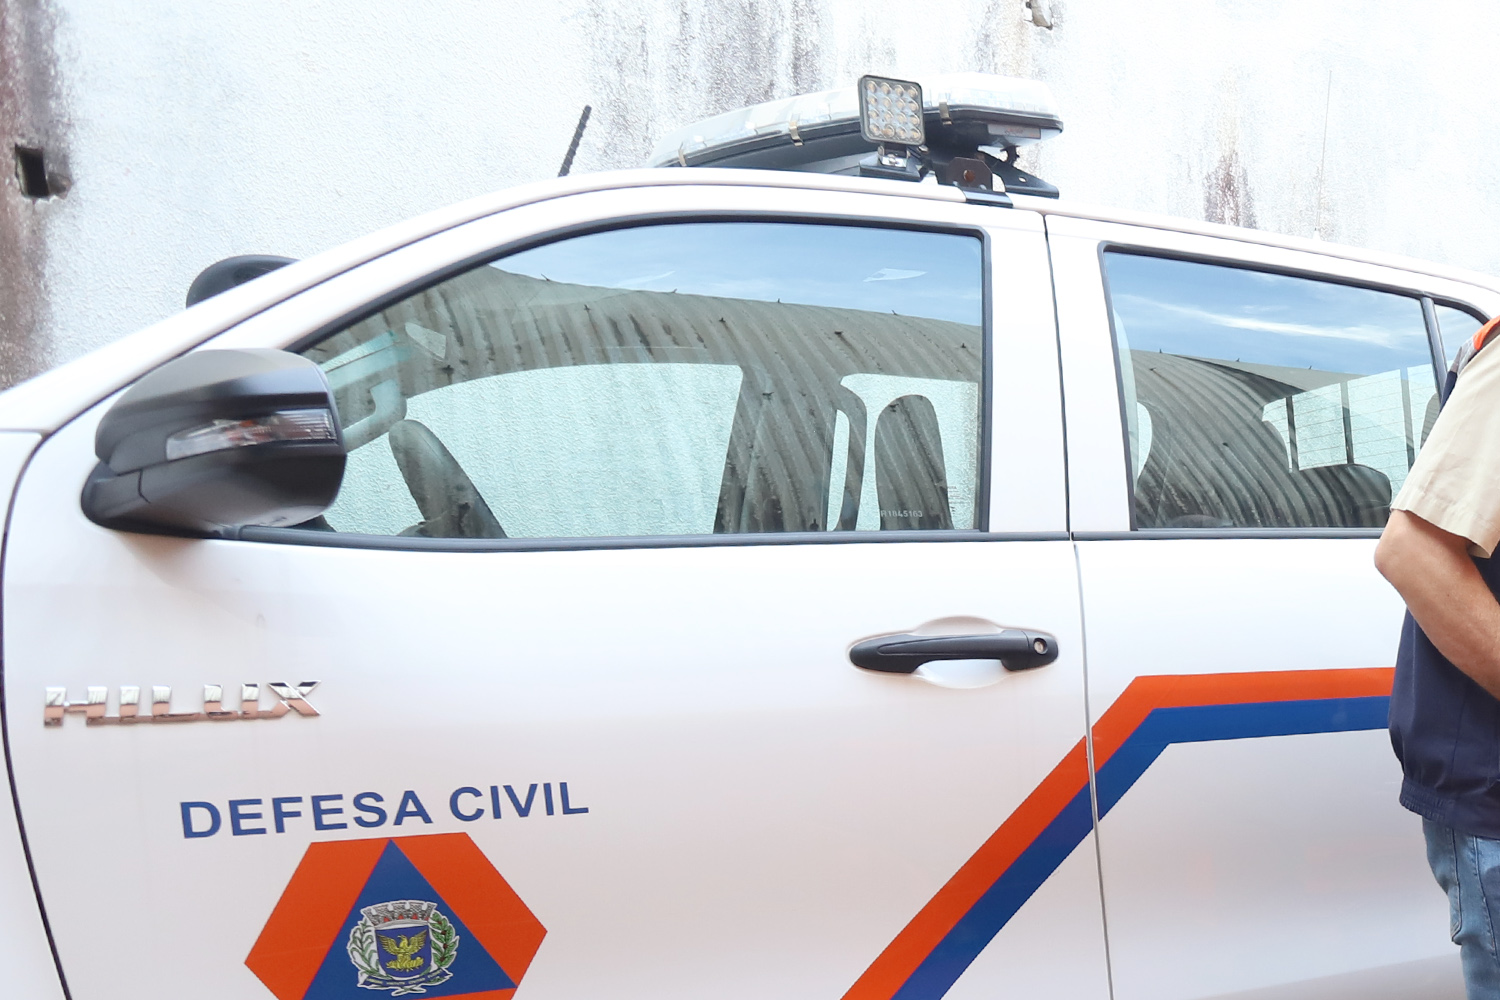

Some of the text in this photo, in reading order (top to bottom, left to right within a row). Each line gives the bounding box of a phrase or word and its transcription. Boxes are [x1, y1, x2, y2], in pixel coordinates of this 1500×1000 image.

[43, 680, 322, 728] HILUX
[180, 781, 590, 839] DEFESA CIVIL
